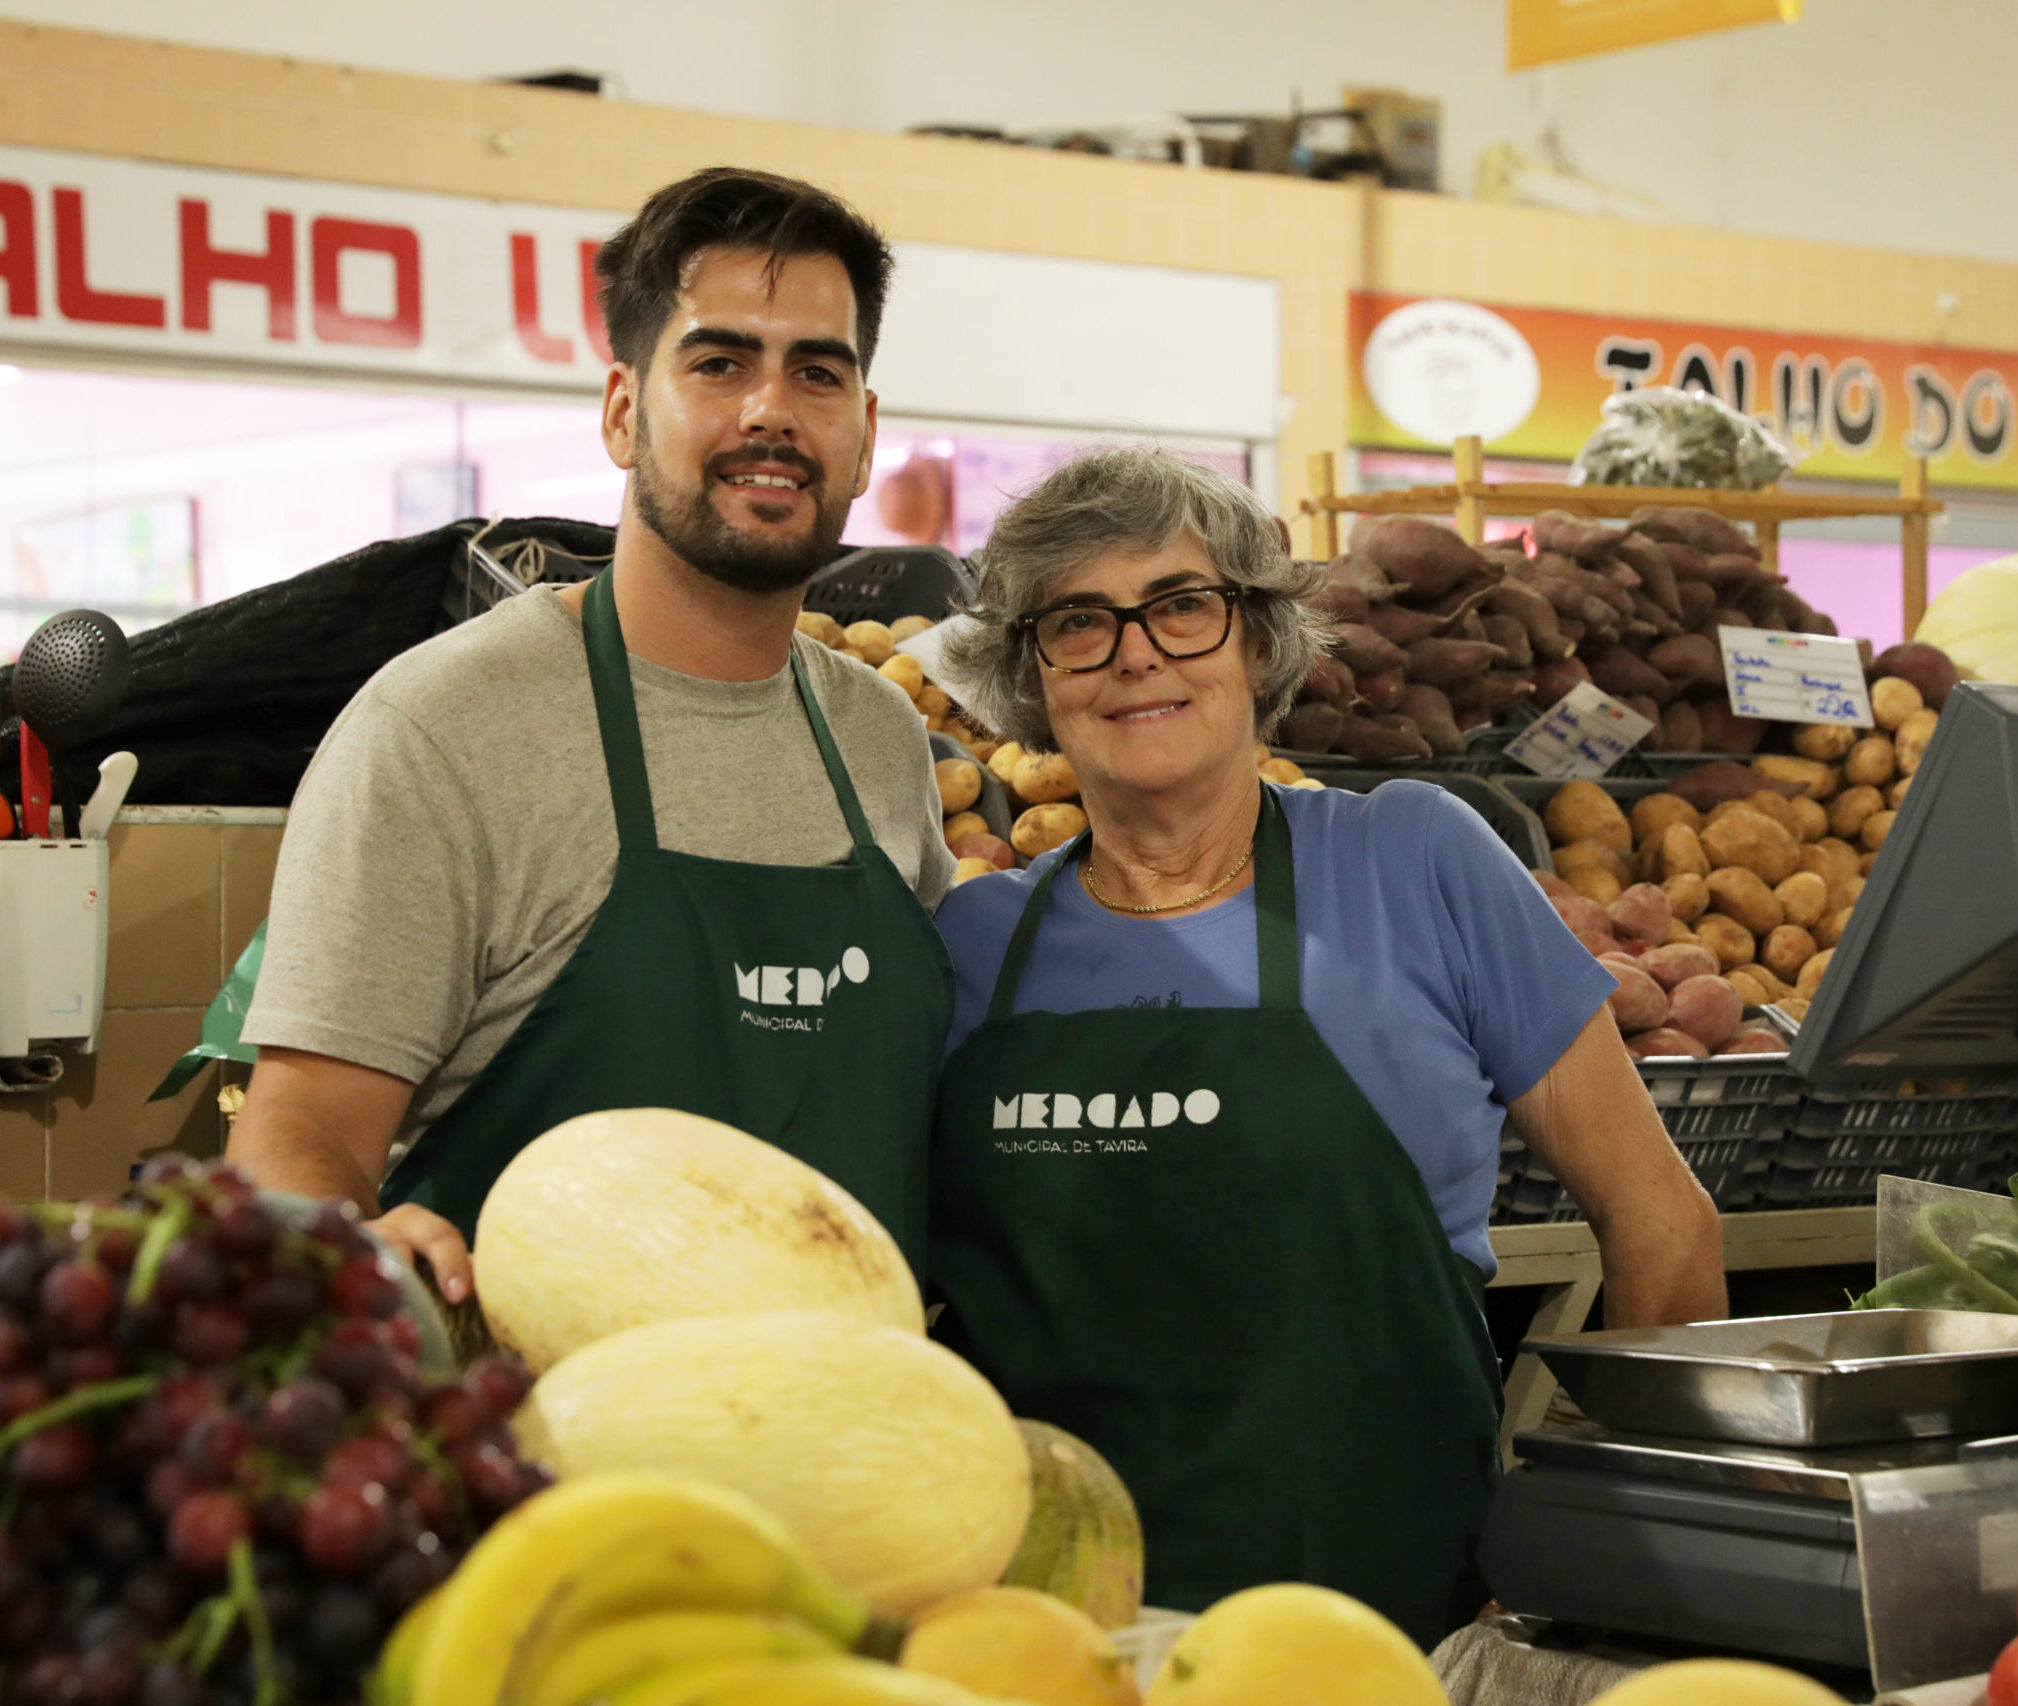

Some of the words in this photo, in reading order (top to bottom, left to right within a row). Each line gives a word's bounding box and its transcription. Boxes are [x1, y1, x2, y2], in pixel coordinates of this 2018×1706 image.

[509, 232, 611, 364] L
[1911, 373, 2008, 455] DO
[993, 1088, 1221, 1129] MERCADO
[1073, 1139, 1092, 1153] DE
[1096, 1139, 1148, 1153] TAVIRA
